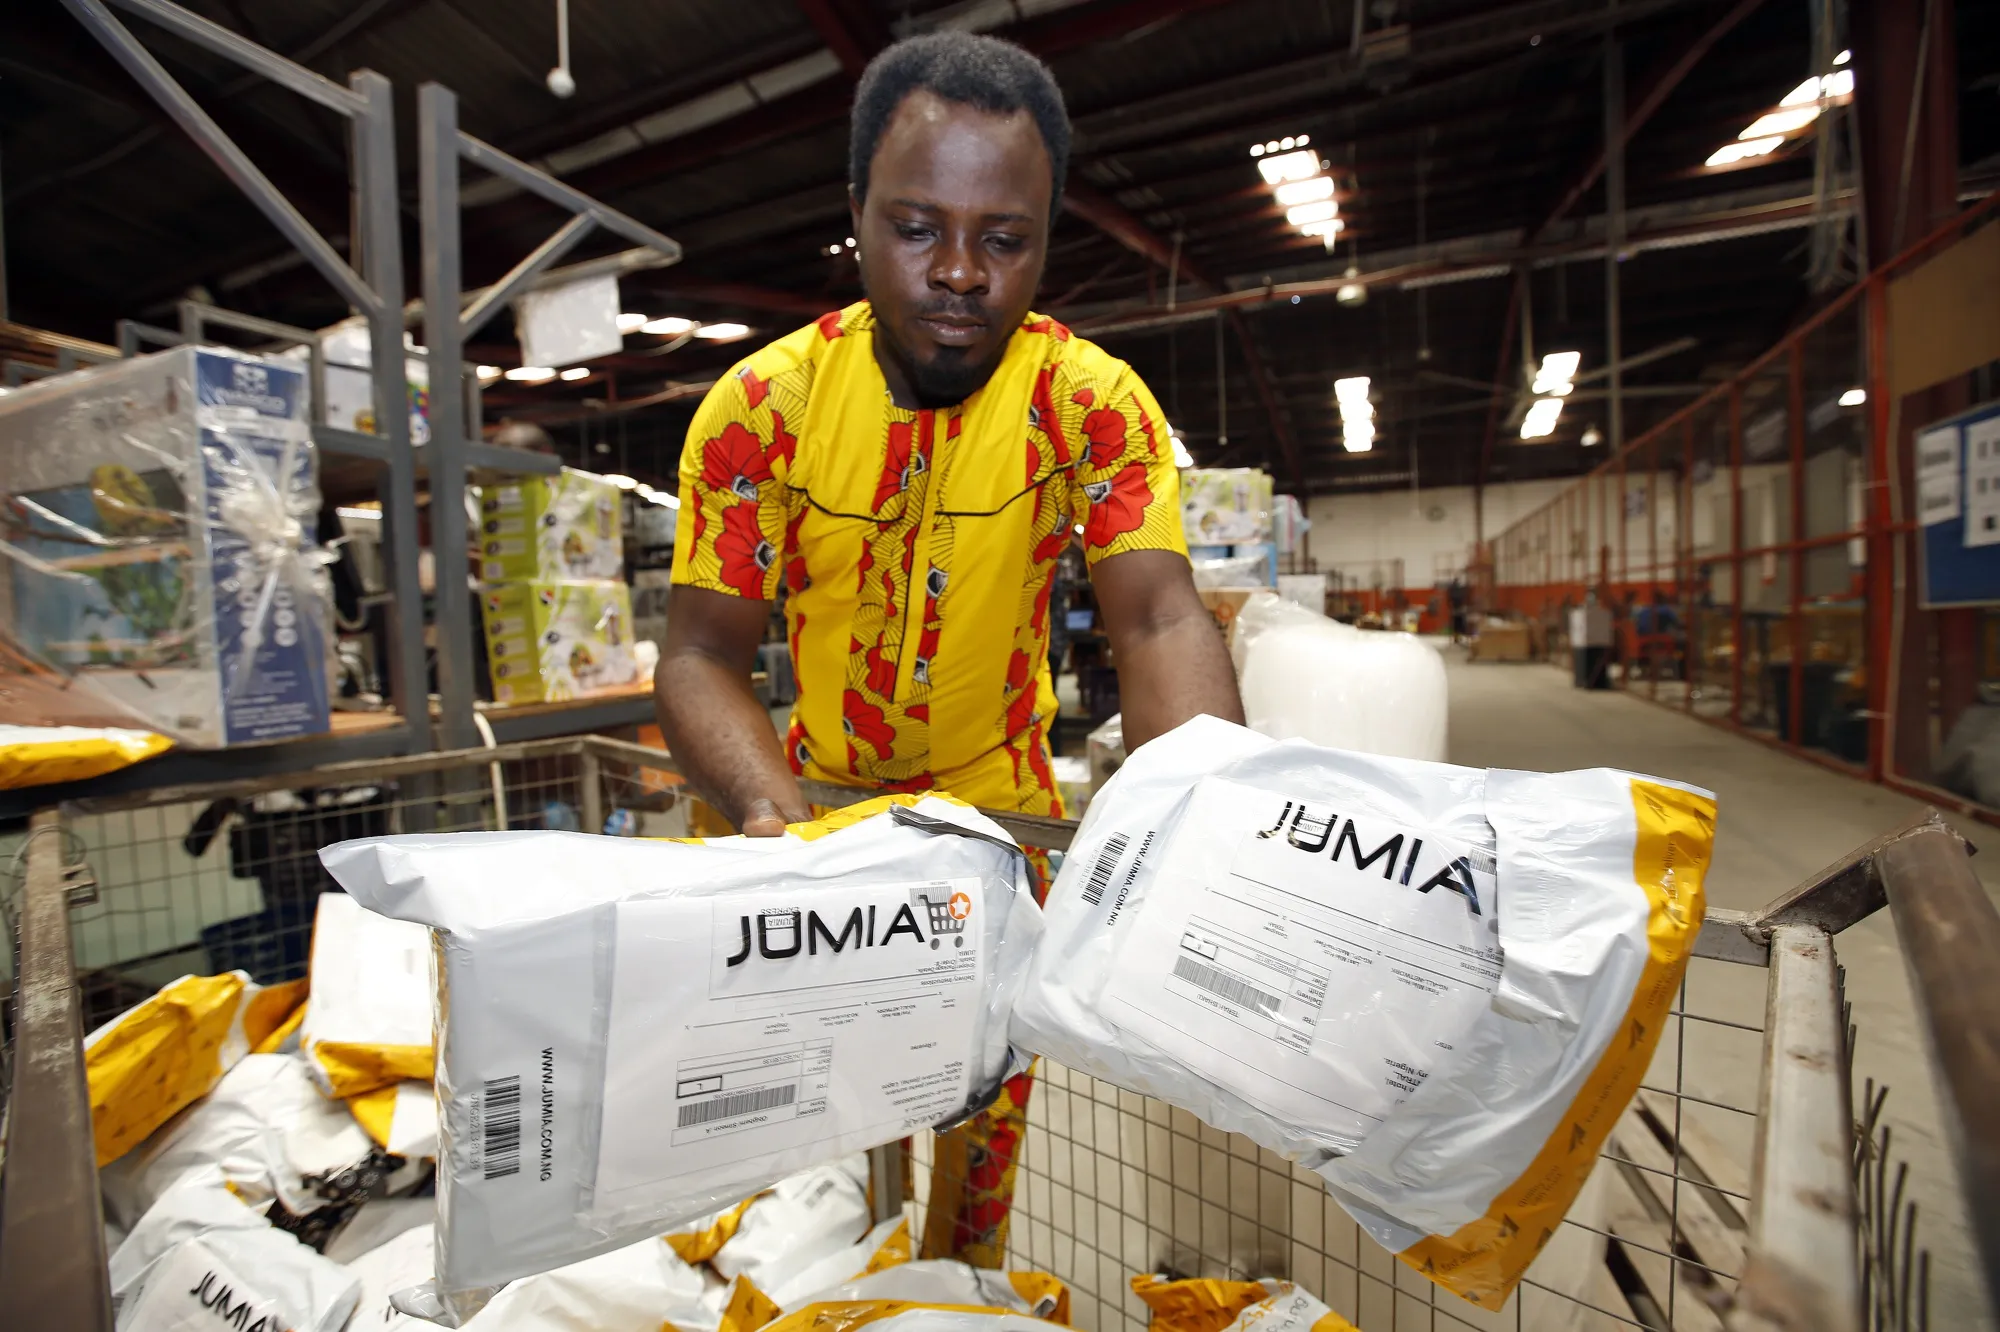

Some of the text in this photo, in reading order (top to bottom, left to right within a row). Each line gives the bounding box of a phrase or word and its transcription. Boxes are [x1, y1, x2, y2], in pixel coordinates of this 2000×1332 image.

[1106, 829, 1155, 926] WWW.JUMIA.COM.NG
[1257, 801, 1482, 917] JUMIA
[726, 902, 925, 968] JUMIA
[540, 1047, 552, 1181] WWW.JUMIA.COM.NG
